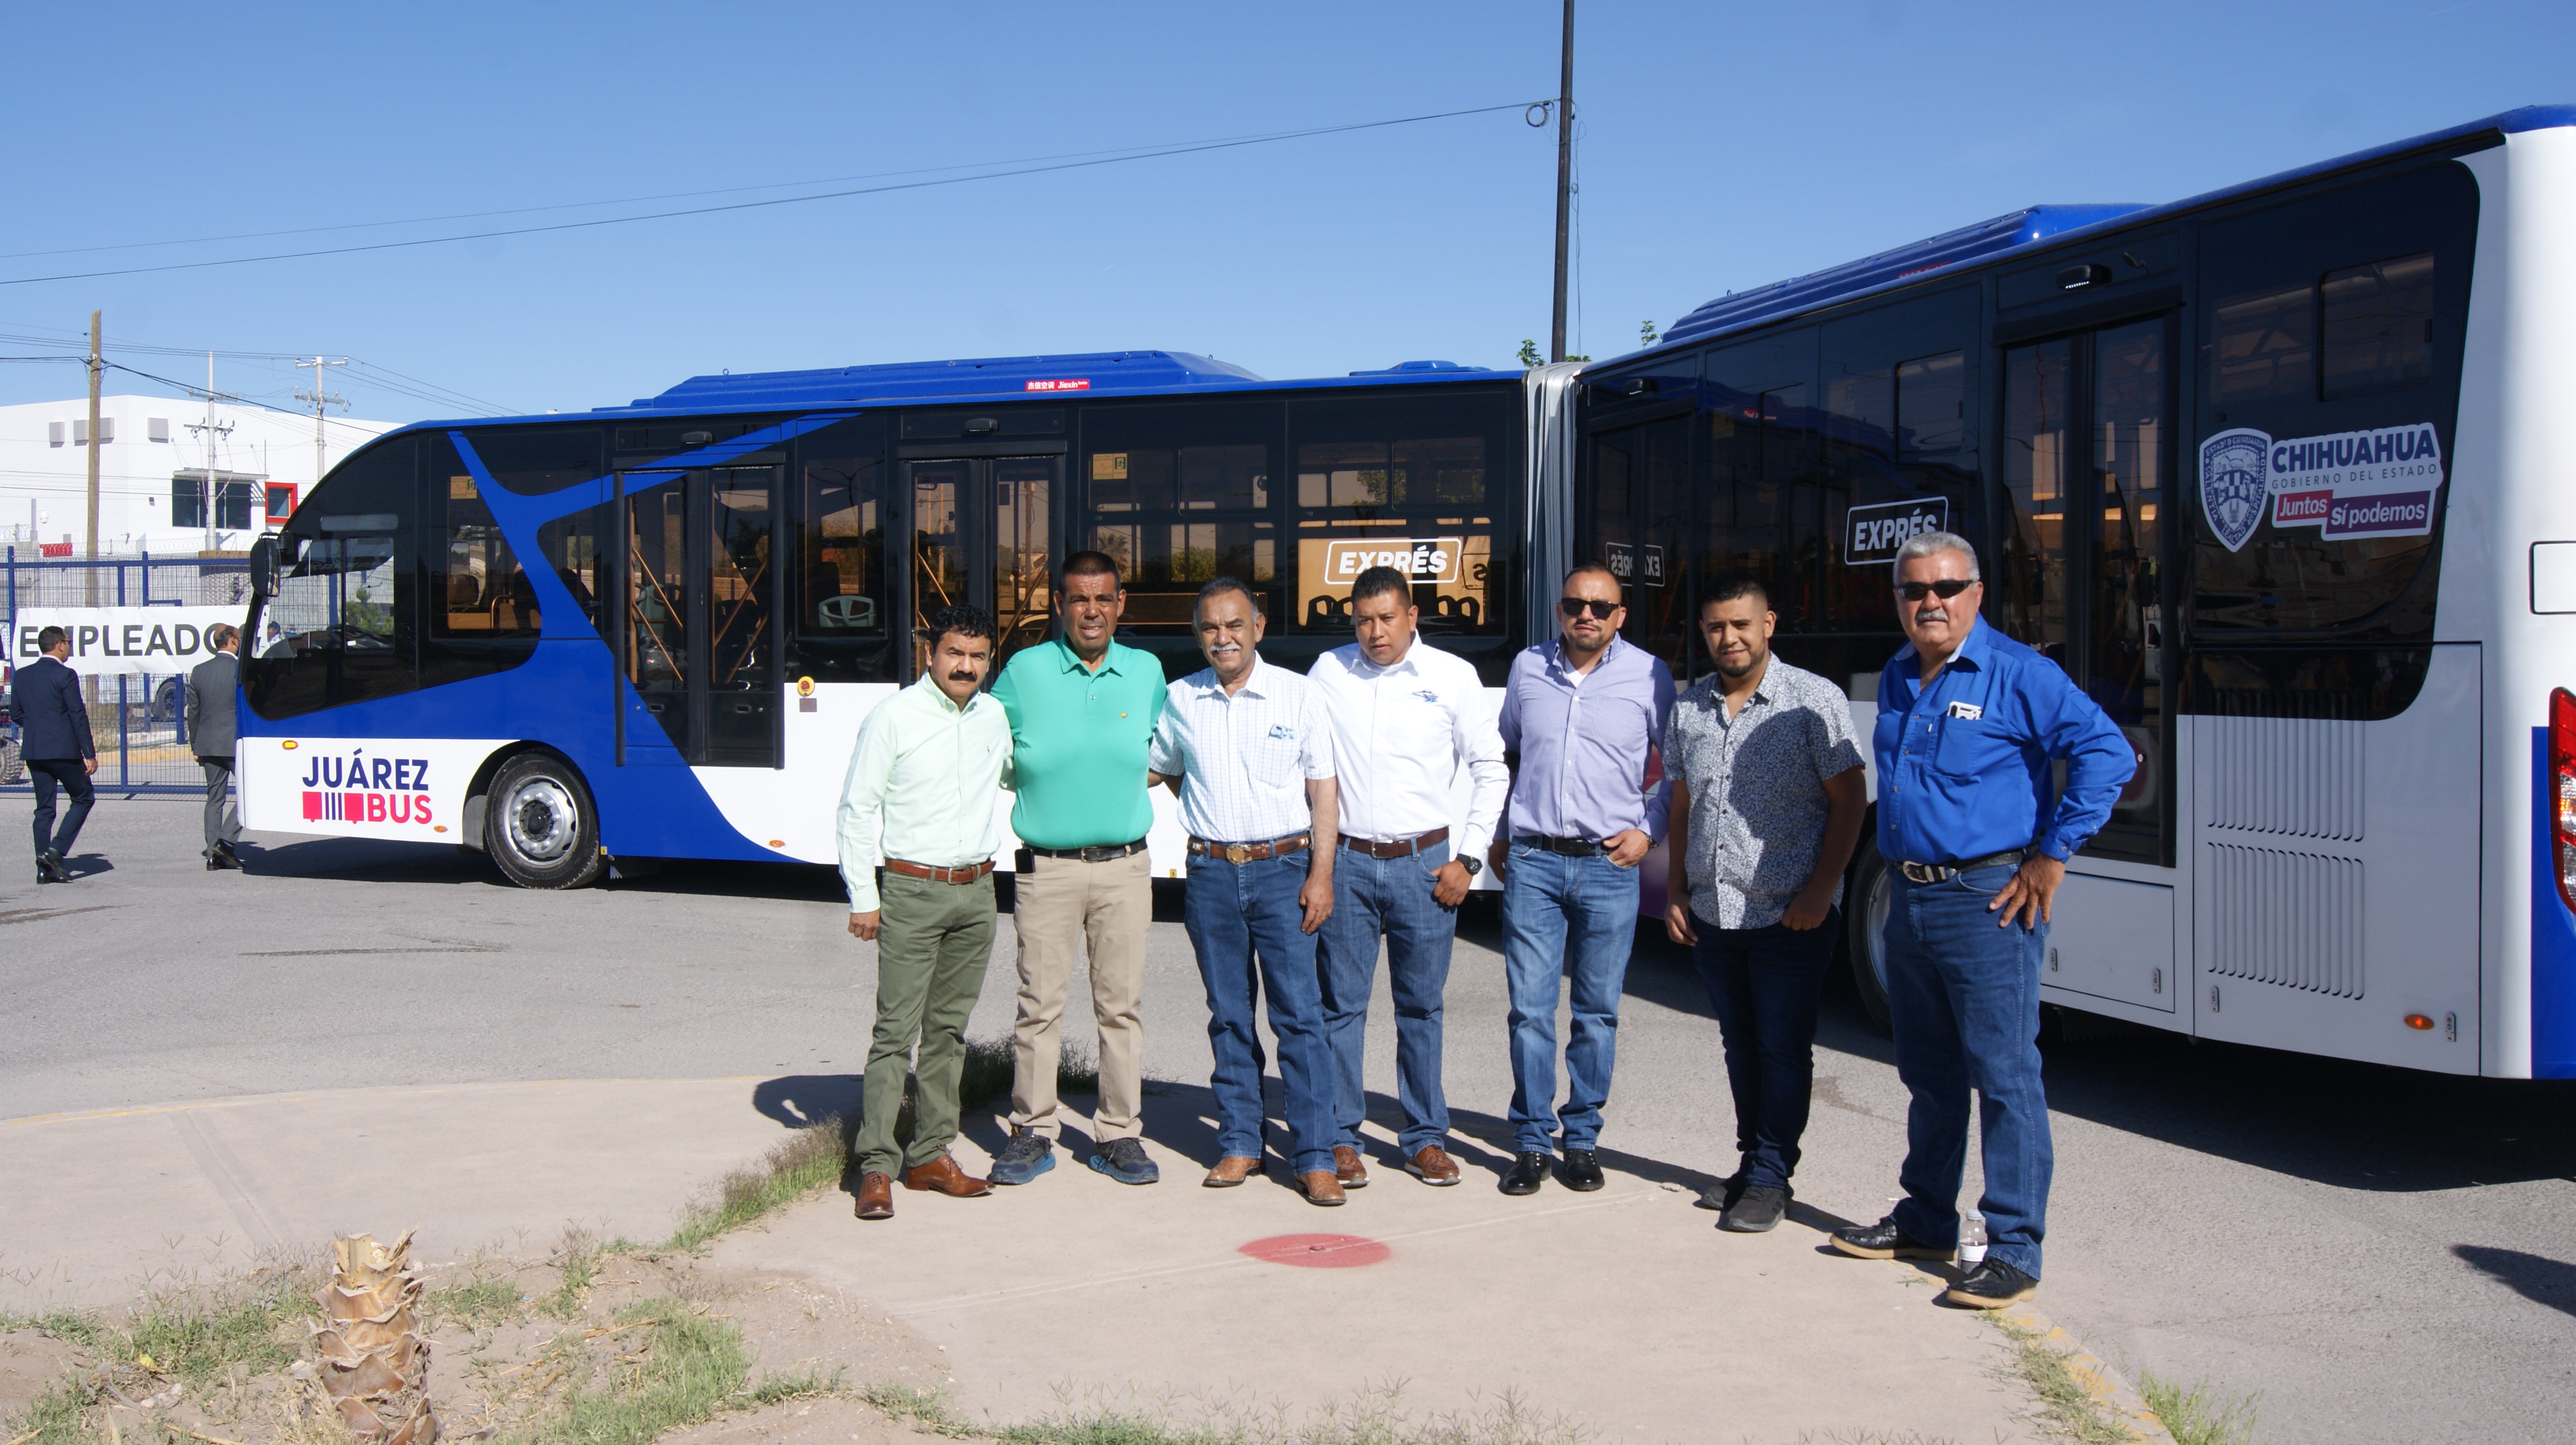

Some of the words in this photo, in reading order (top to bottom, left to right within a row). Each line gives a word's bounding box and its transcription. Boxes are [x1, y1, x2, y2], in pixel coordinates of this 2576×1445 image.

[2272, 430, 2436, 473] CHIHUAHUA
[2272, 473, 2340, 489] GOBIERNO
[2350, 471, 2373, 482] DEL
[2382, 464, 2436, 478] ESTADO
[2280, 496, 2327, 517] Juntos
[2348, 501, 2425, 528] podemos
[1854, 507, 1937, 551] EXPRÉS
[1339, 545, 1448, 574] EXPRÉS
[302, 747, 429, 790] JUÁREZ
[367, 793, 432, 824] BUS
